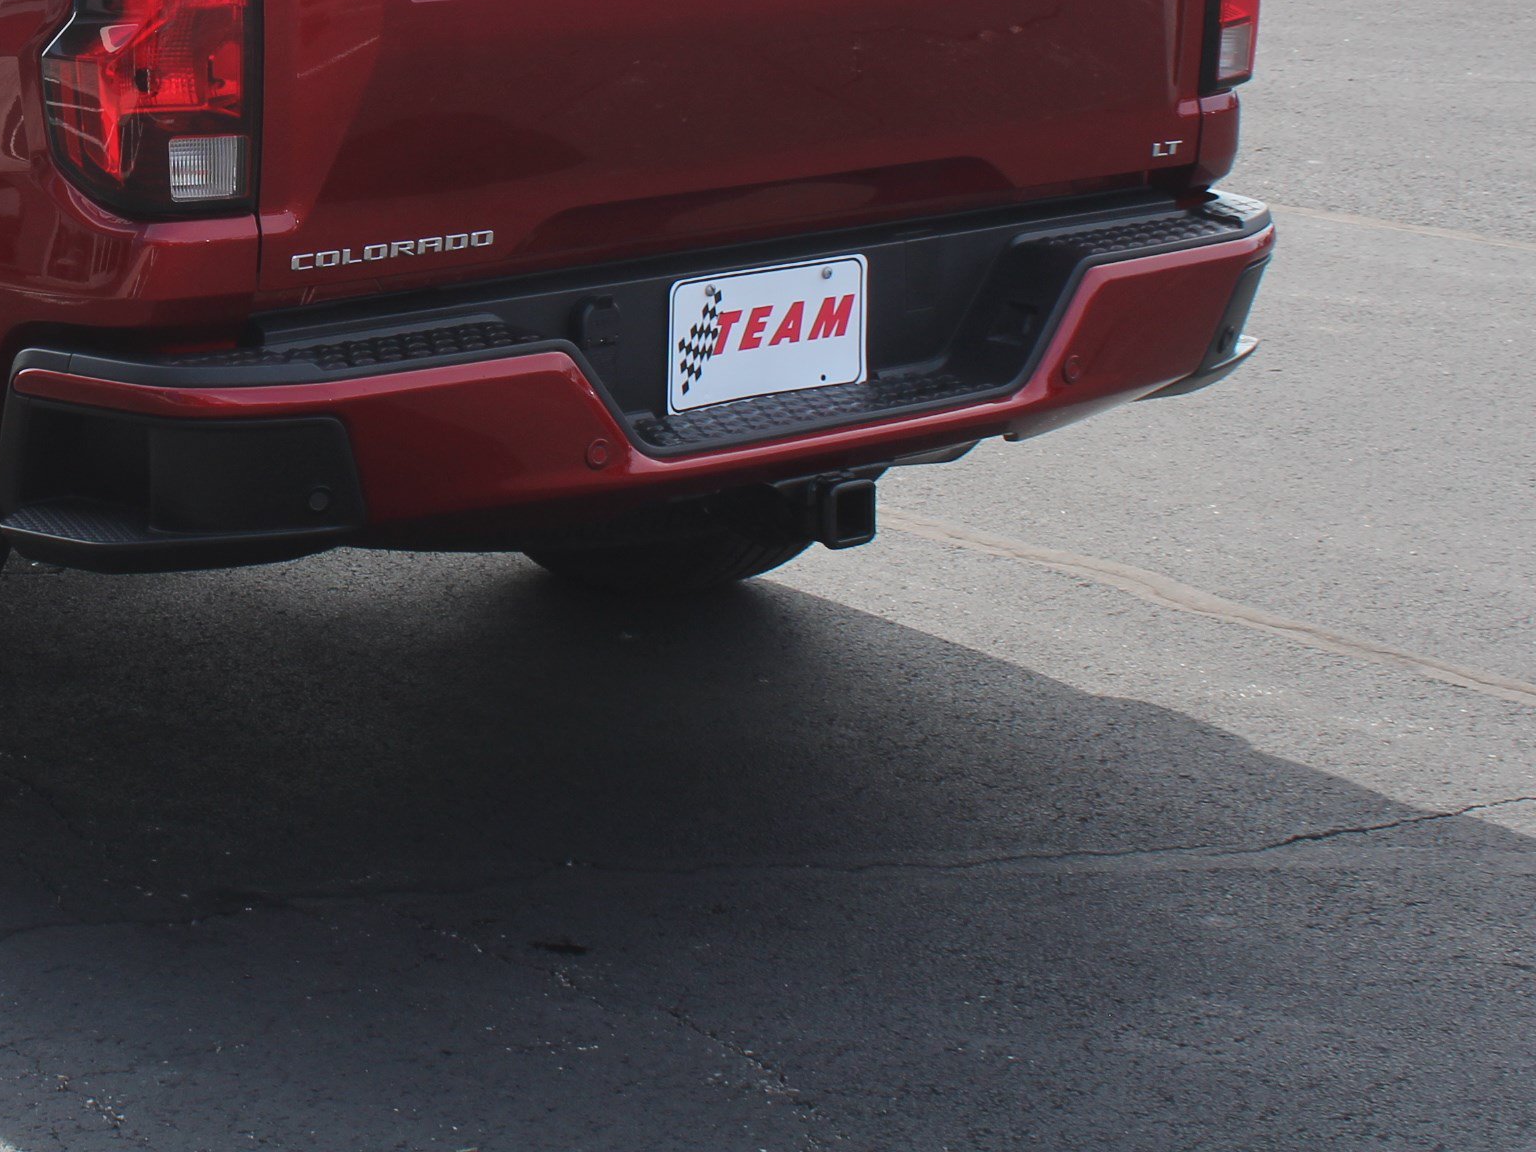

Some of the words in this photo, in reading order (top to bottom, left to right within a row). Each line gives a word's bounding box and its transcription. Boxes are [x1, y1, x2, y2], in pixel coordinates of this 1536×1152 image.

[1152, 140, 1183, 157] LT
[290, 229, 494, 272] COLORADO
[712, 293, 856, 356] TEAM
